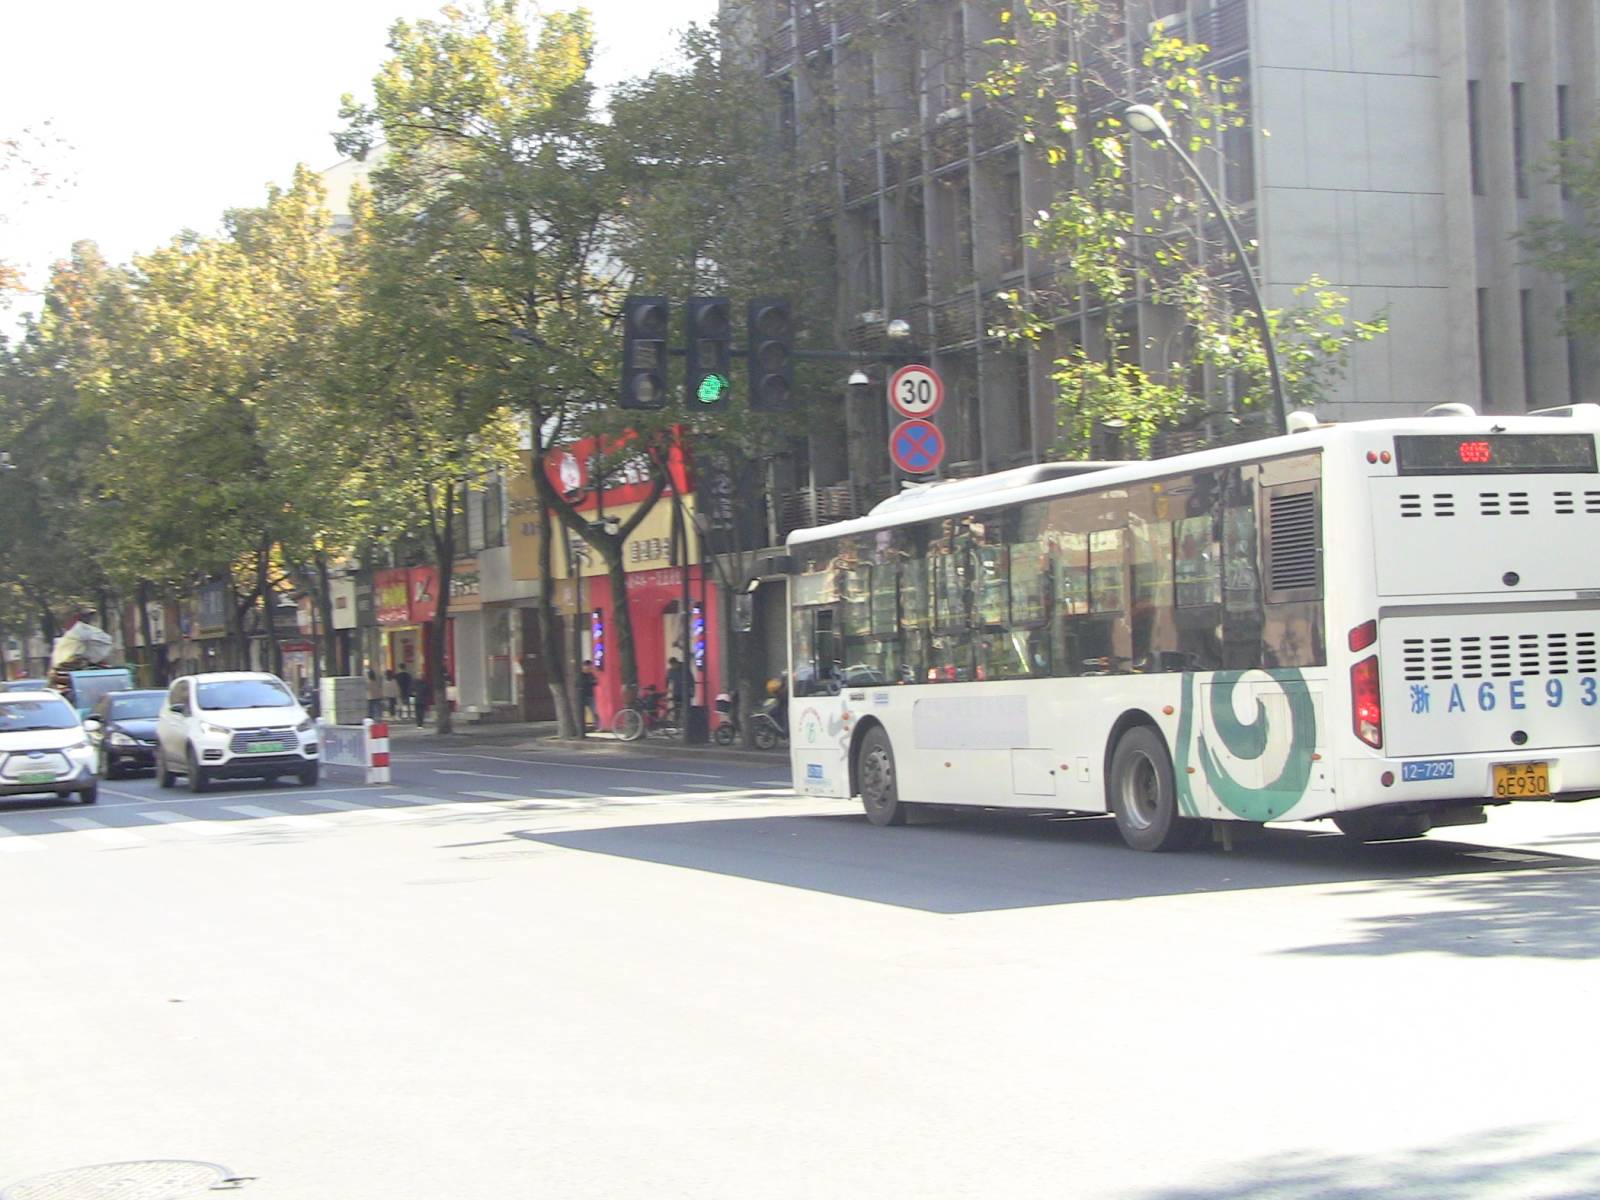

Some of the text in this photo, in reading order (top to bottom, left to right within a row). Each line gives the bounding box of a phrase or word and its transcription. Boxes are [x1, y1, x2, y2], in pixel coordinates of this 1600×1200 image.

[902, 379, 930, 404] 30
[1403, 761, 1453, 780] 12-7292
[1496, 776, 1546, 795] 6E930
